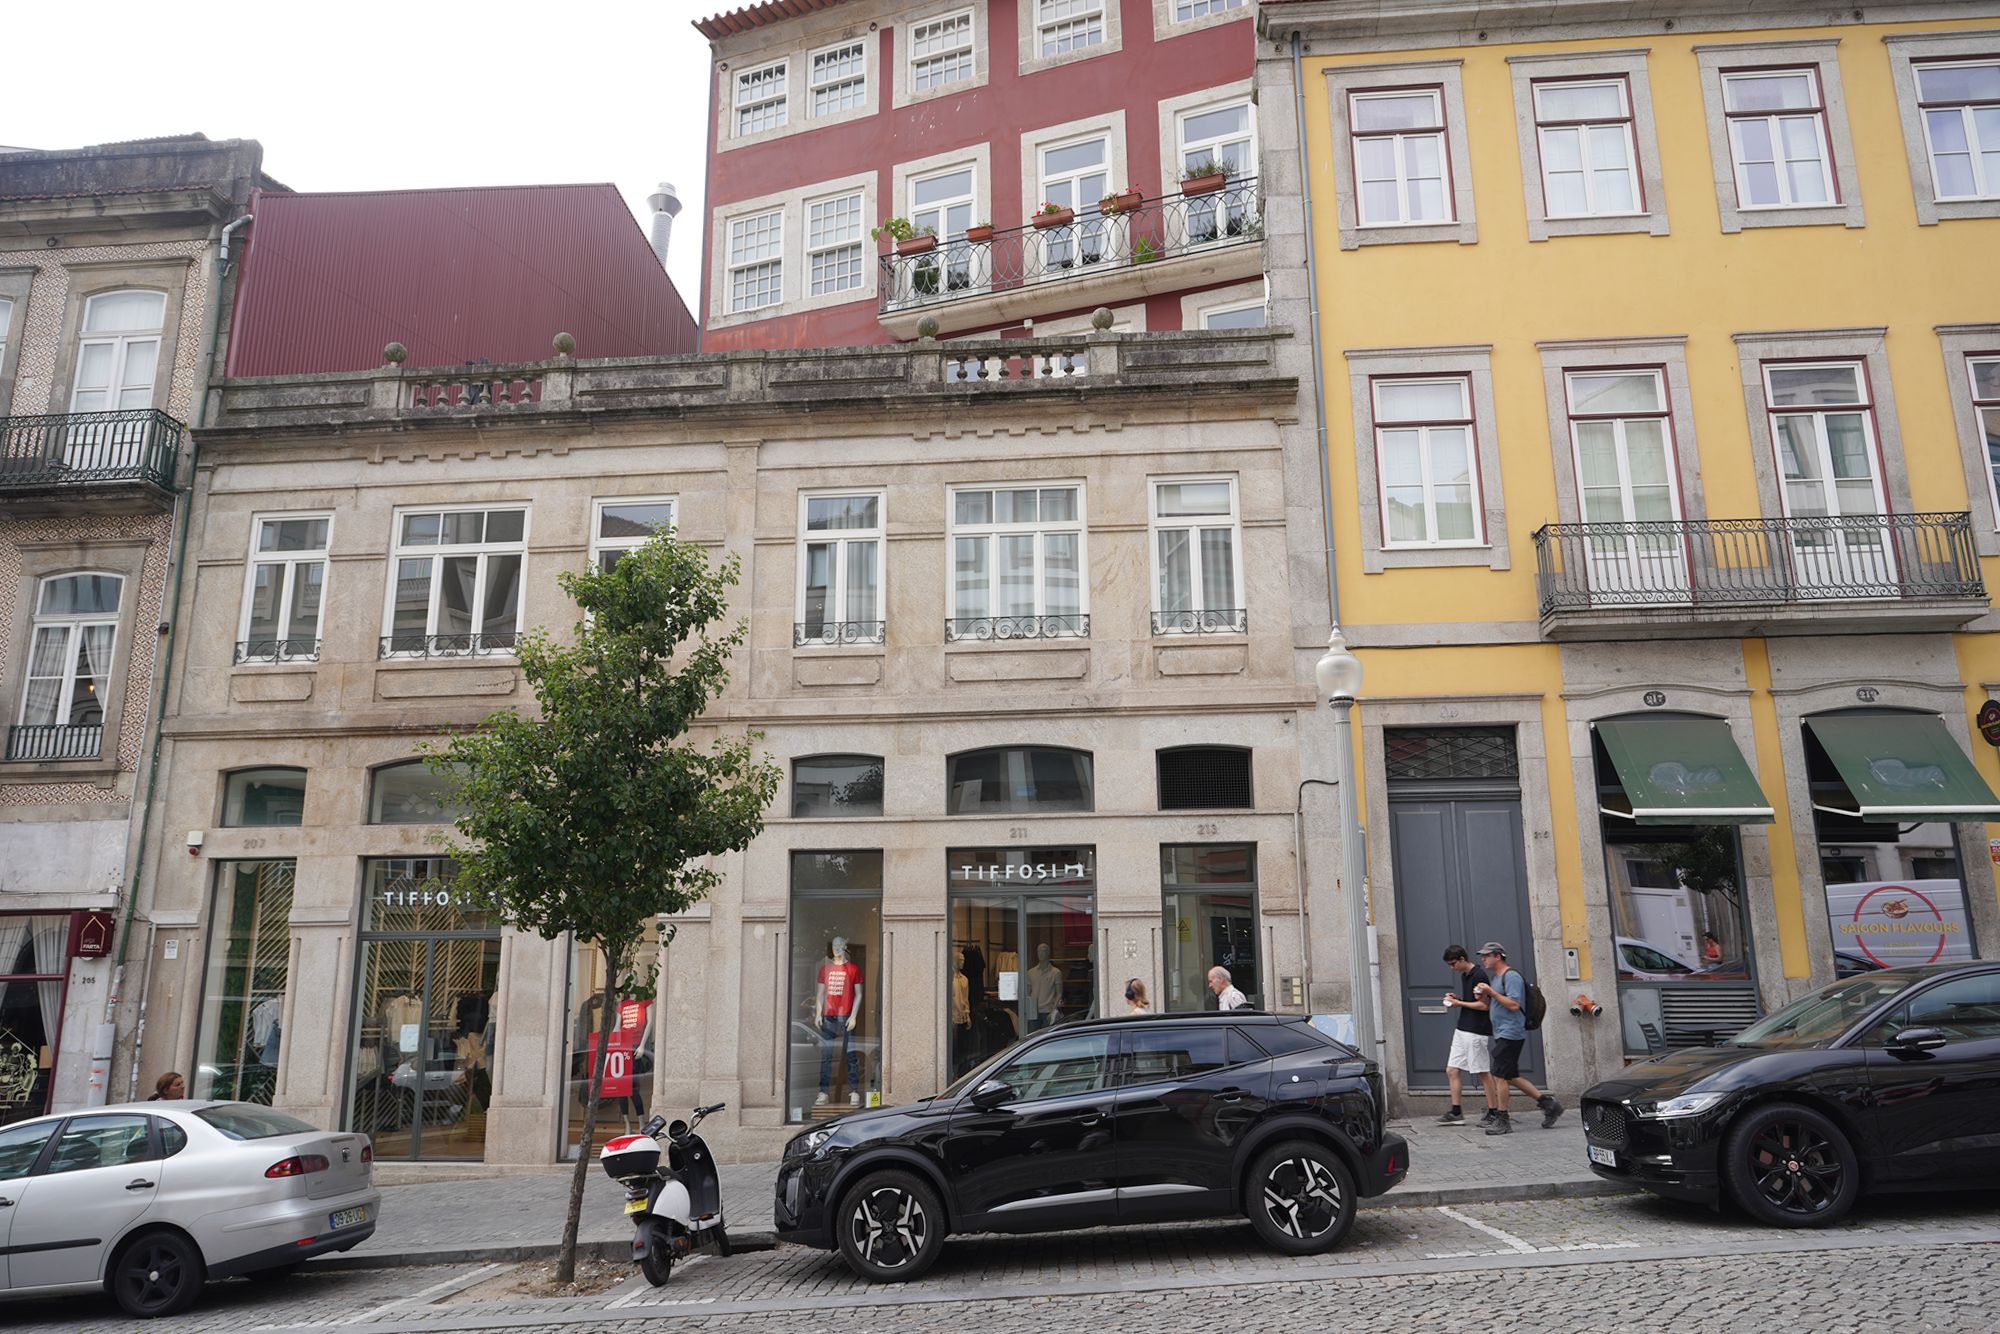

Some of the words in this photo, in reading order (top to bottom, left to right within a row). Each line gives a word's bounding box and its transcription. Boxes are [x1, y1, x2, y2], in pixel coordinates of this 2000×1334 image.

[1009, 828, 1028, 838] 211
[243, 838, 266, 849] 207
[962, 863, 1056, 880] TIFFOSI
[1839, 922, 1889, 934] SAIGON
[1892, 922, 1960, 933] FLAVOURS
